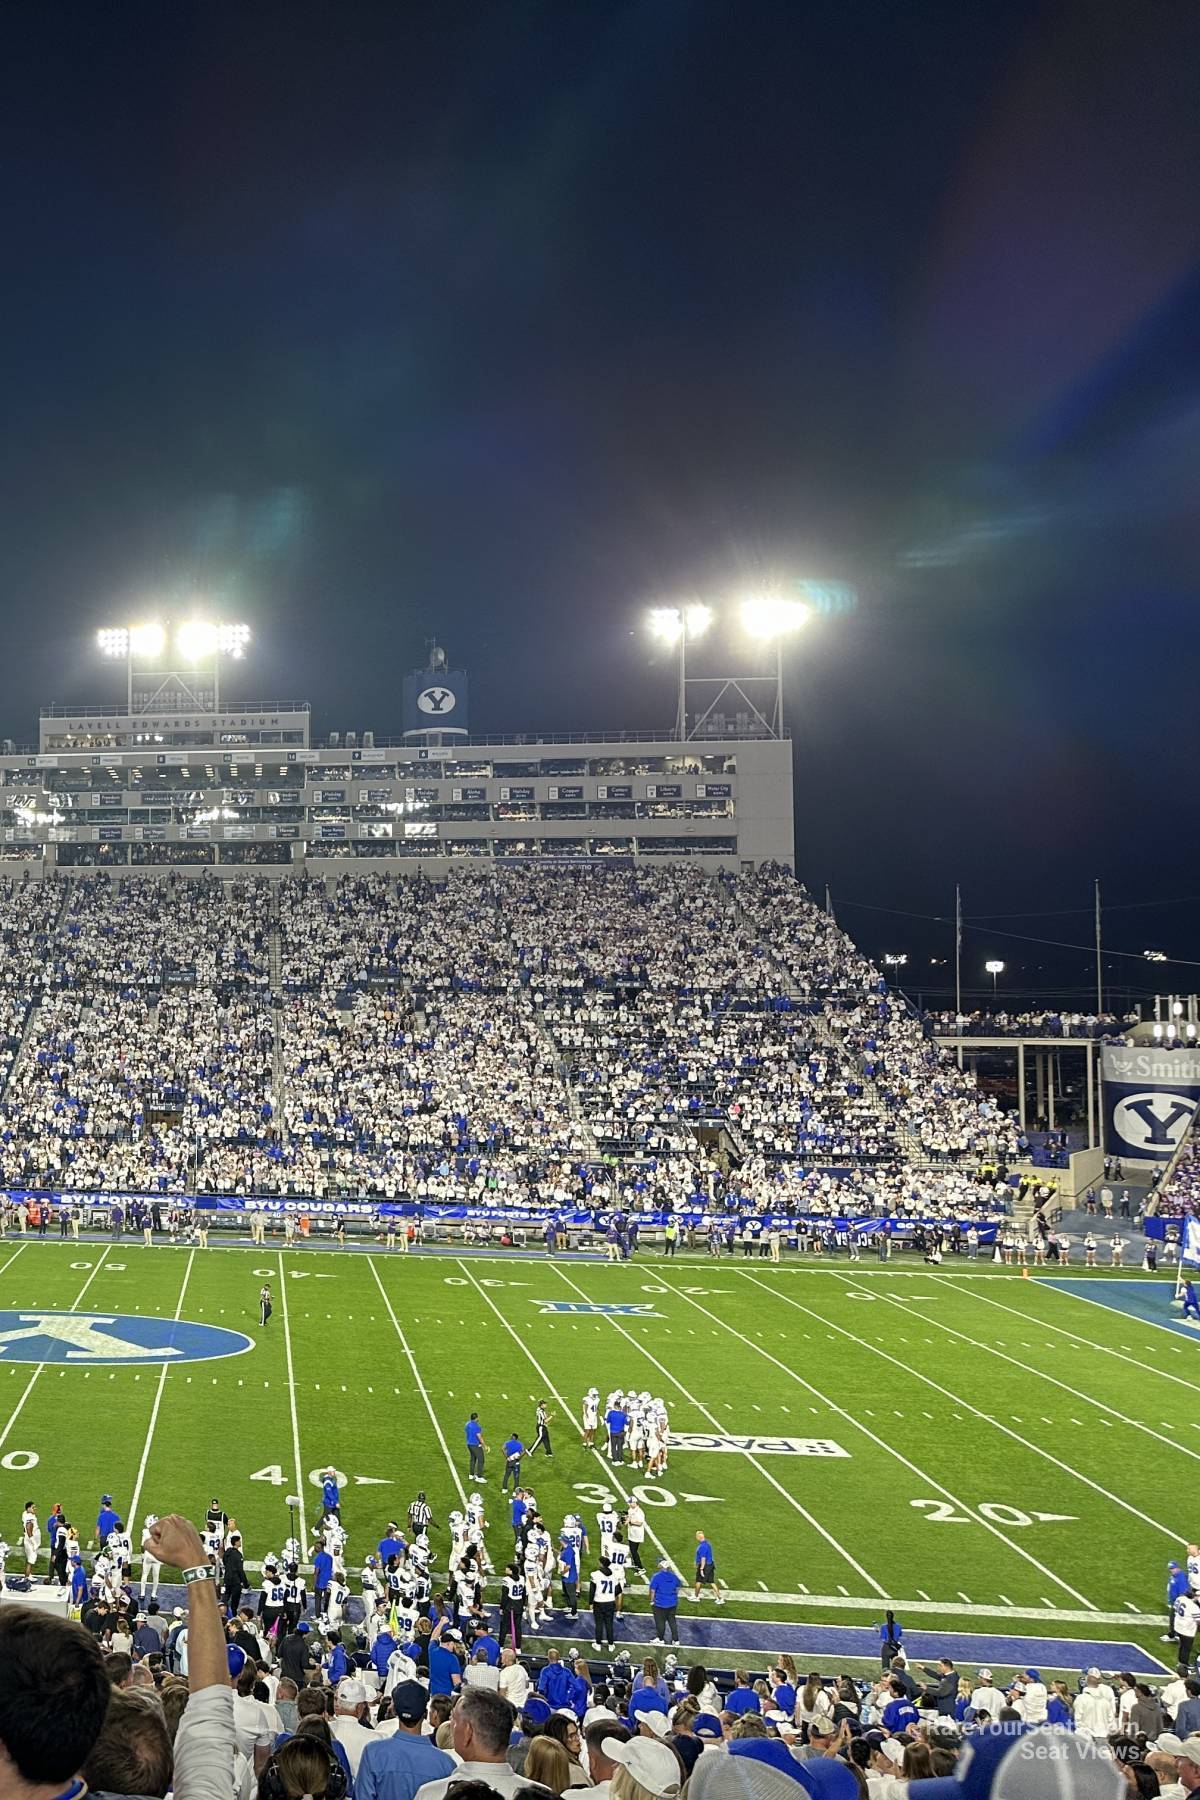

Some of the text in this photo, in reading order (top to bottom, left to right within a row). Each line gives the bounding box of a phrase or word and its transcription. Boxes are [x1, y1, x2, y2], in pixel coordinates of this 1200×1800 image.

[424, 690, 450, 711] Y
[69, 717, 279, 731] LAVELL EDWARDS STADIUM
[1124, 1099, 1195, 1145] Y
[60, 1195, 97, 1205] BYU
[244, 1201, 373, 1213] BYU COUGARS
[467, 1209, 491, 1217] BYU
[69, 1261, 128, 1272] 50
[250, 1464, 348, 1489] 40
[572, 1482, 677, 1507] 30
[909, 1498, 1033, 1527] 20
[601, 1520, 613, 1533] 13
[612, 1552, 626, 1565] 10
[271, 1587, 284, 1601] 66
[511, 1584, 525, 1597] 82
[601, 1580, 614, 1594] 71
